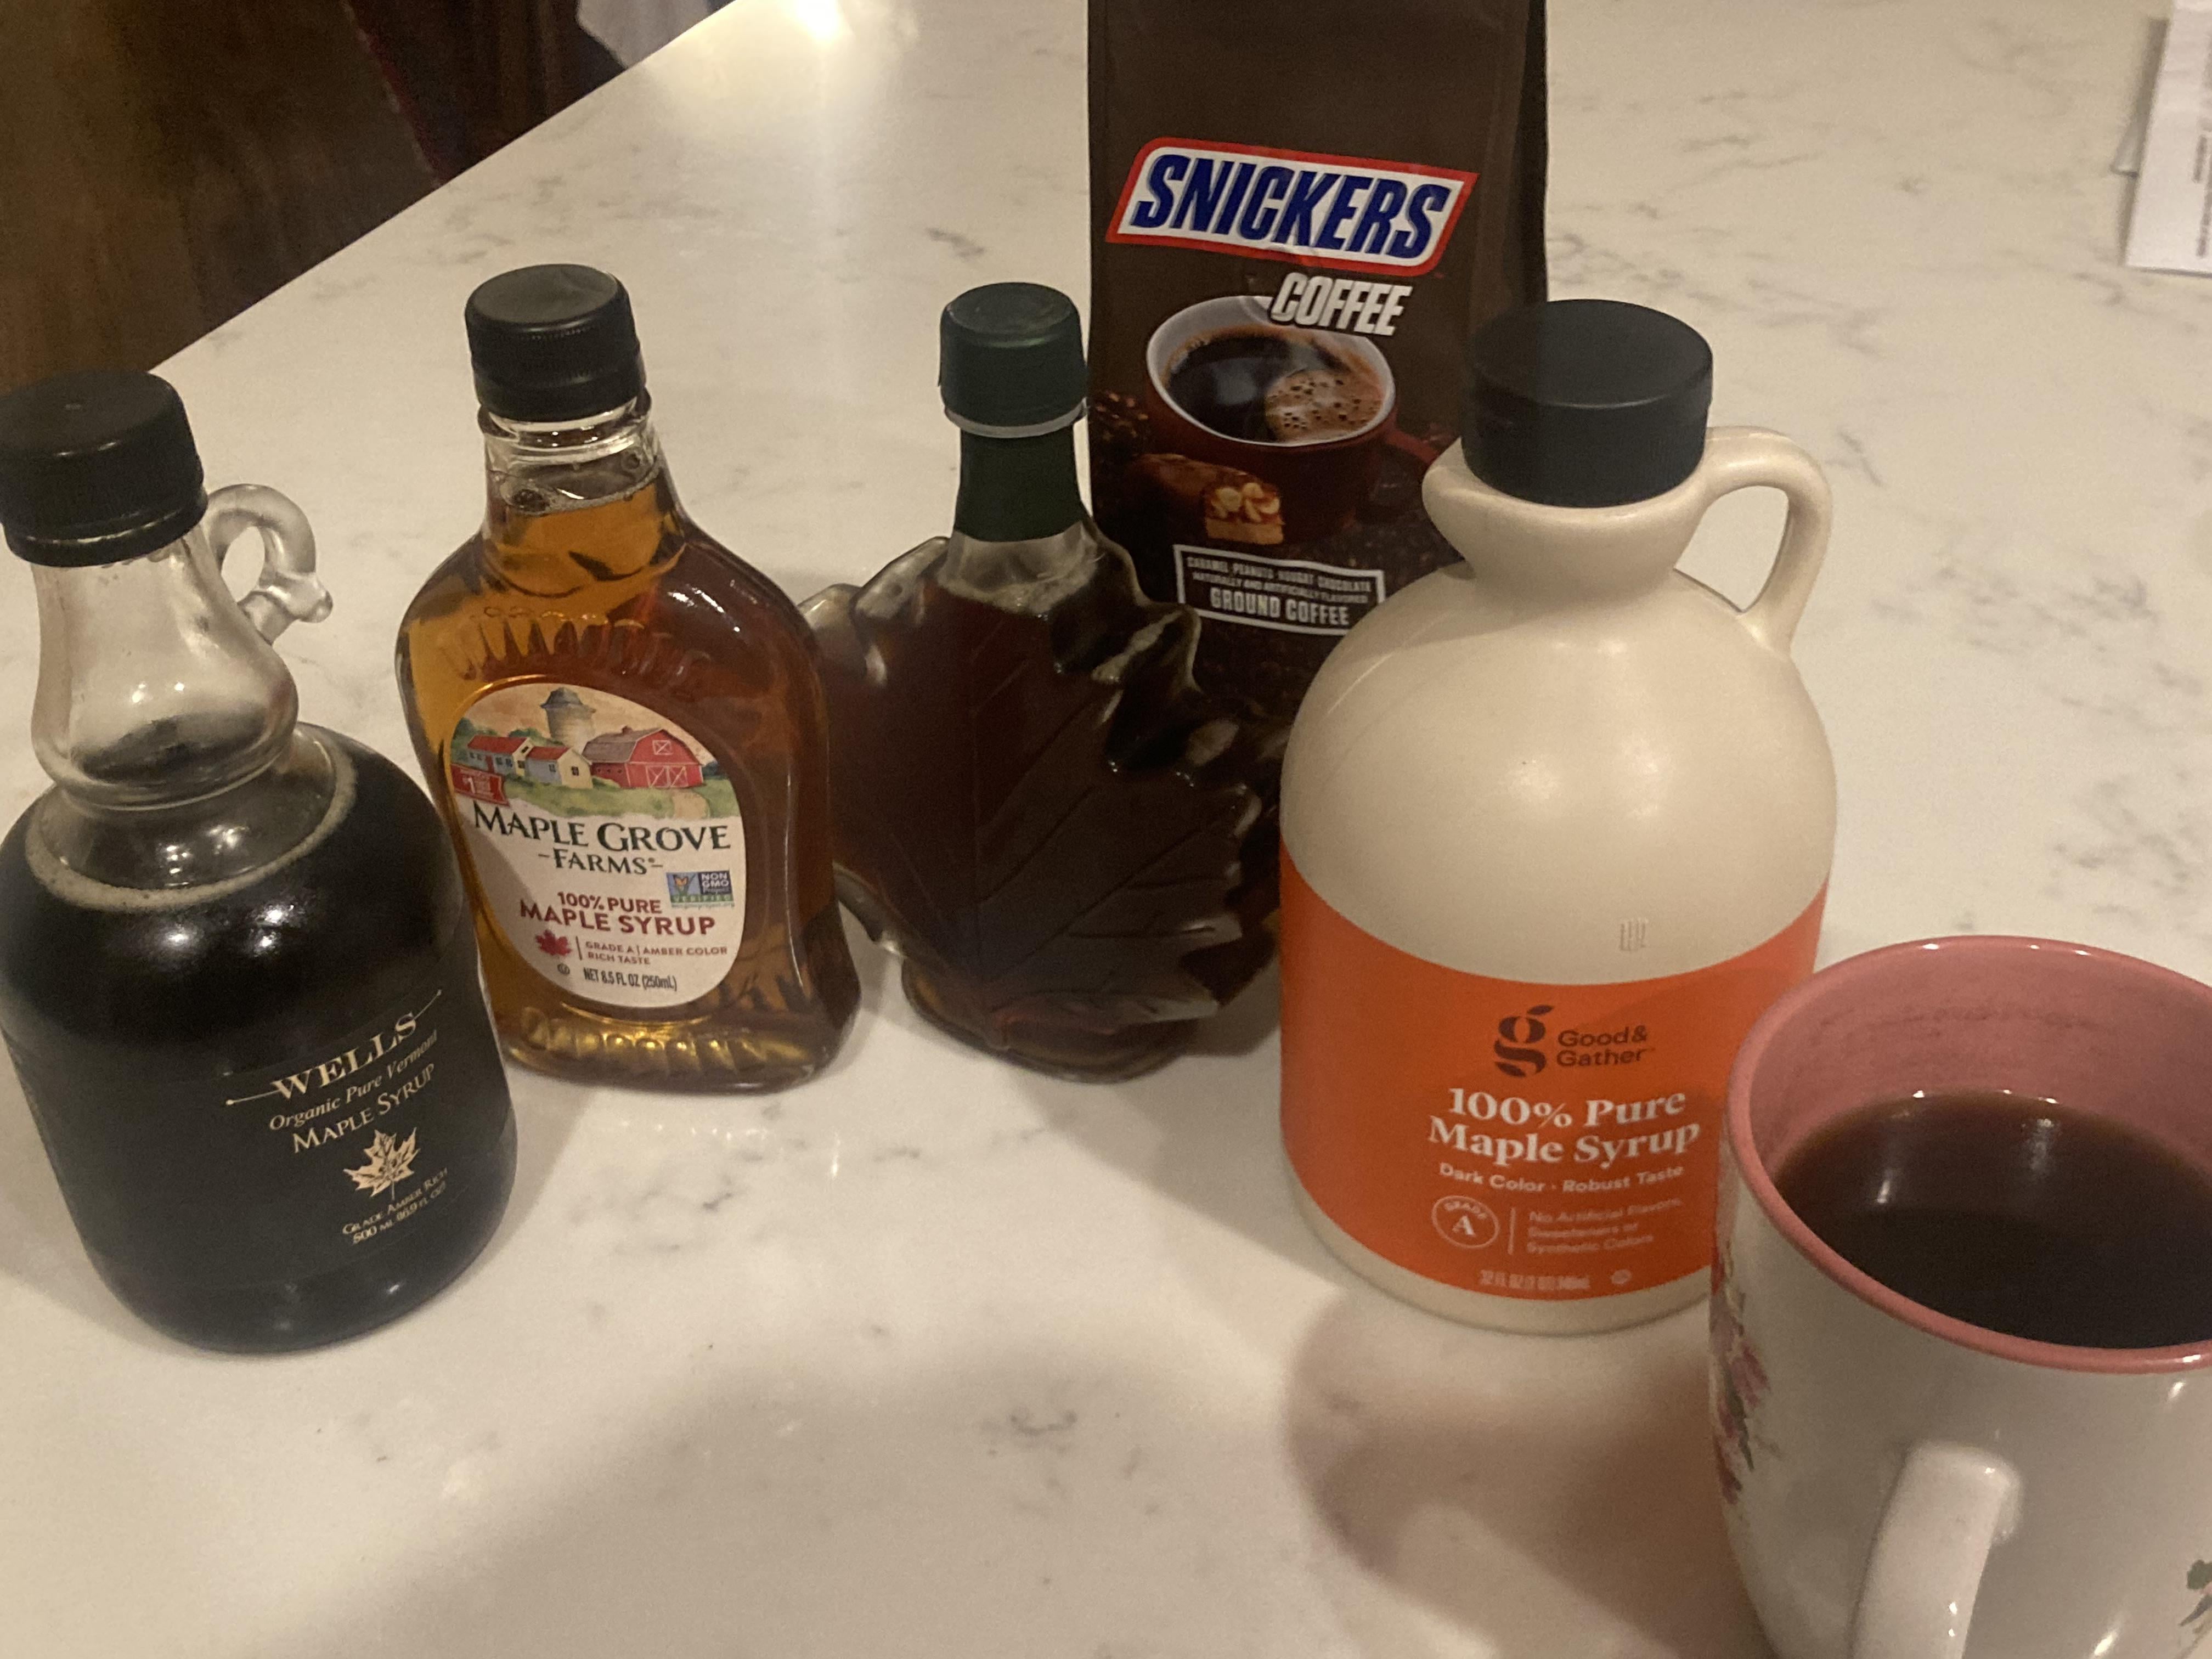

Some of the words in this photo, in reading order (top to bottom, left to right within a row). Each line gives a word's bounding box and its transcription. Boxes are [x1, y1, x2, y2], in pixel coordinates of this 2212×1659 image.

[1129, 153, 1452, 259] SNICKERS
[1269, 272, 1413, 336] COFFEE
[1210, 586, 1281, 618] GROUND
[1285, 598, 1350, 626] COFFEE
[473, 801, 589, 847] MAPLE
[597, 822, 731, 851] GROVE
[702, 872, 727, 881] NON
[702, 879, 729, 888] GMO
[520, 899, 611, 932] MAPLE
[618, 915, 716, 935] SYRUP
[557, 891, 604, 910] 100%
[608, 898, 662, 914] PURE
[586, 941, 623, 953] GRADE
[643, 947, 683, 956] AMBER
[686, 946, 727, 956] COLOR
[588, 952, 615, 962] RICH
[618, 956, 651, 965] TASTE
[584, 967, 599, 982] NET
[617, 973, 627, 985] FL
[629, 974, 641, 987] OZ
[1558, 1025, 1649, 1047] Good&
[270, 1012, 416, 1099] WELLS
[1556, 1048, 1645, 1067] Gather
[269, 1098, 340, 1130] Organic
[346, 1076, 382, 1104] Pure
[387, 1029, 437, 1079] Vermont
[292, 1108, 375, 1153] MAPLE
[377, 1063, 435, 1115] SYRUP
[1448, 1088, 1573, 1128] 100%
[1584, 1092, 1686, 1127] Pure
[1429, 1115, 1565, 1167] Maple
[1573, 1122, 1700, 1170] Syrup
[1439, 1163, 1483, 1184] Dark
[1489, 1174, 1545, 1193] Color
[1562, 1177, 1630, 1193] Robust
[1637, 1165, 1684, 1186] Taste
[353, 1225, 377, 1244] 500
[1452, 1215, 1476, 1236] A
